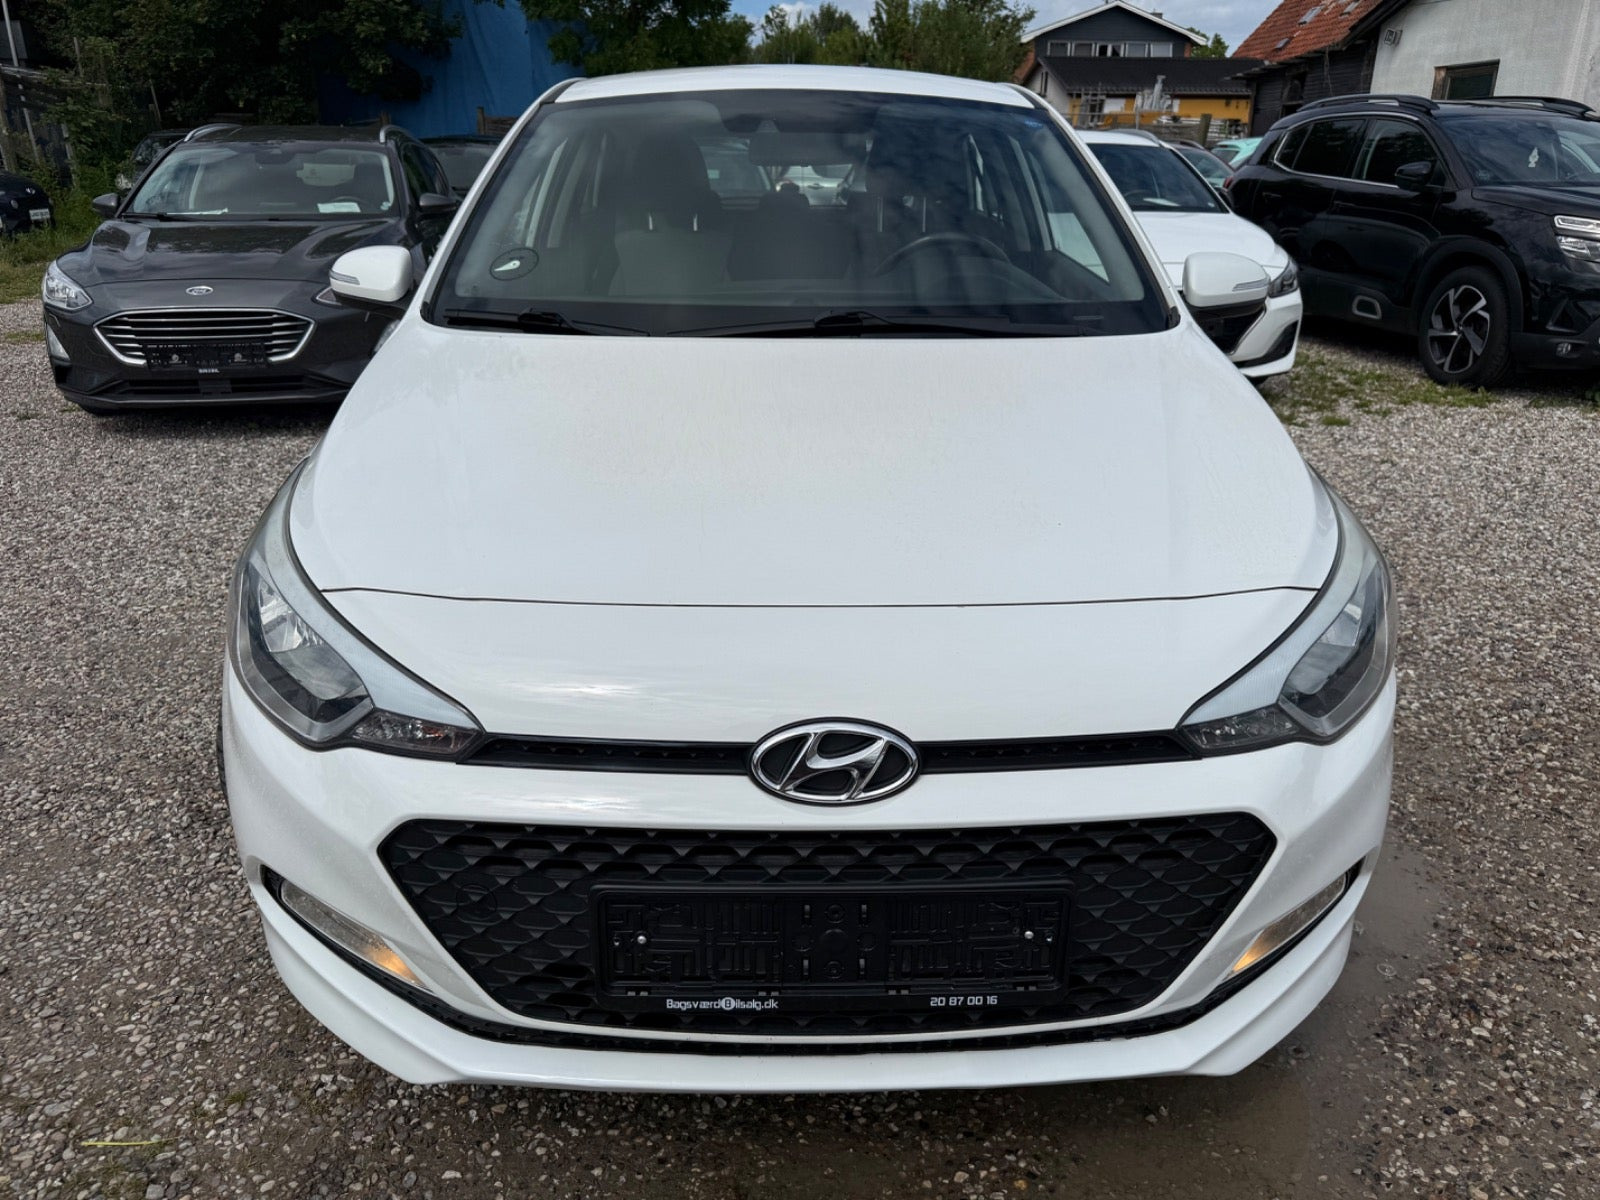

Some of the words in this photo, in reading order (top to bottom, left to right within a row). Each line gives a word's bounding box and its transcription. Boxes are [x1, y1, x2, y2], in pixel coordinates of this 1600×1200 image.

[930, 997, 946, 1006] 20
[948, 996, 964, 1006] 87
[966, 996, 983, 1005] 00
[986, 995, 998, 1005] 16
